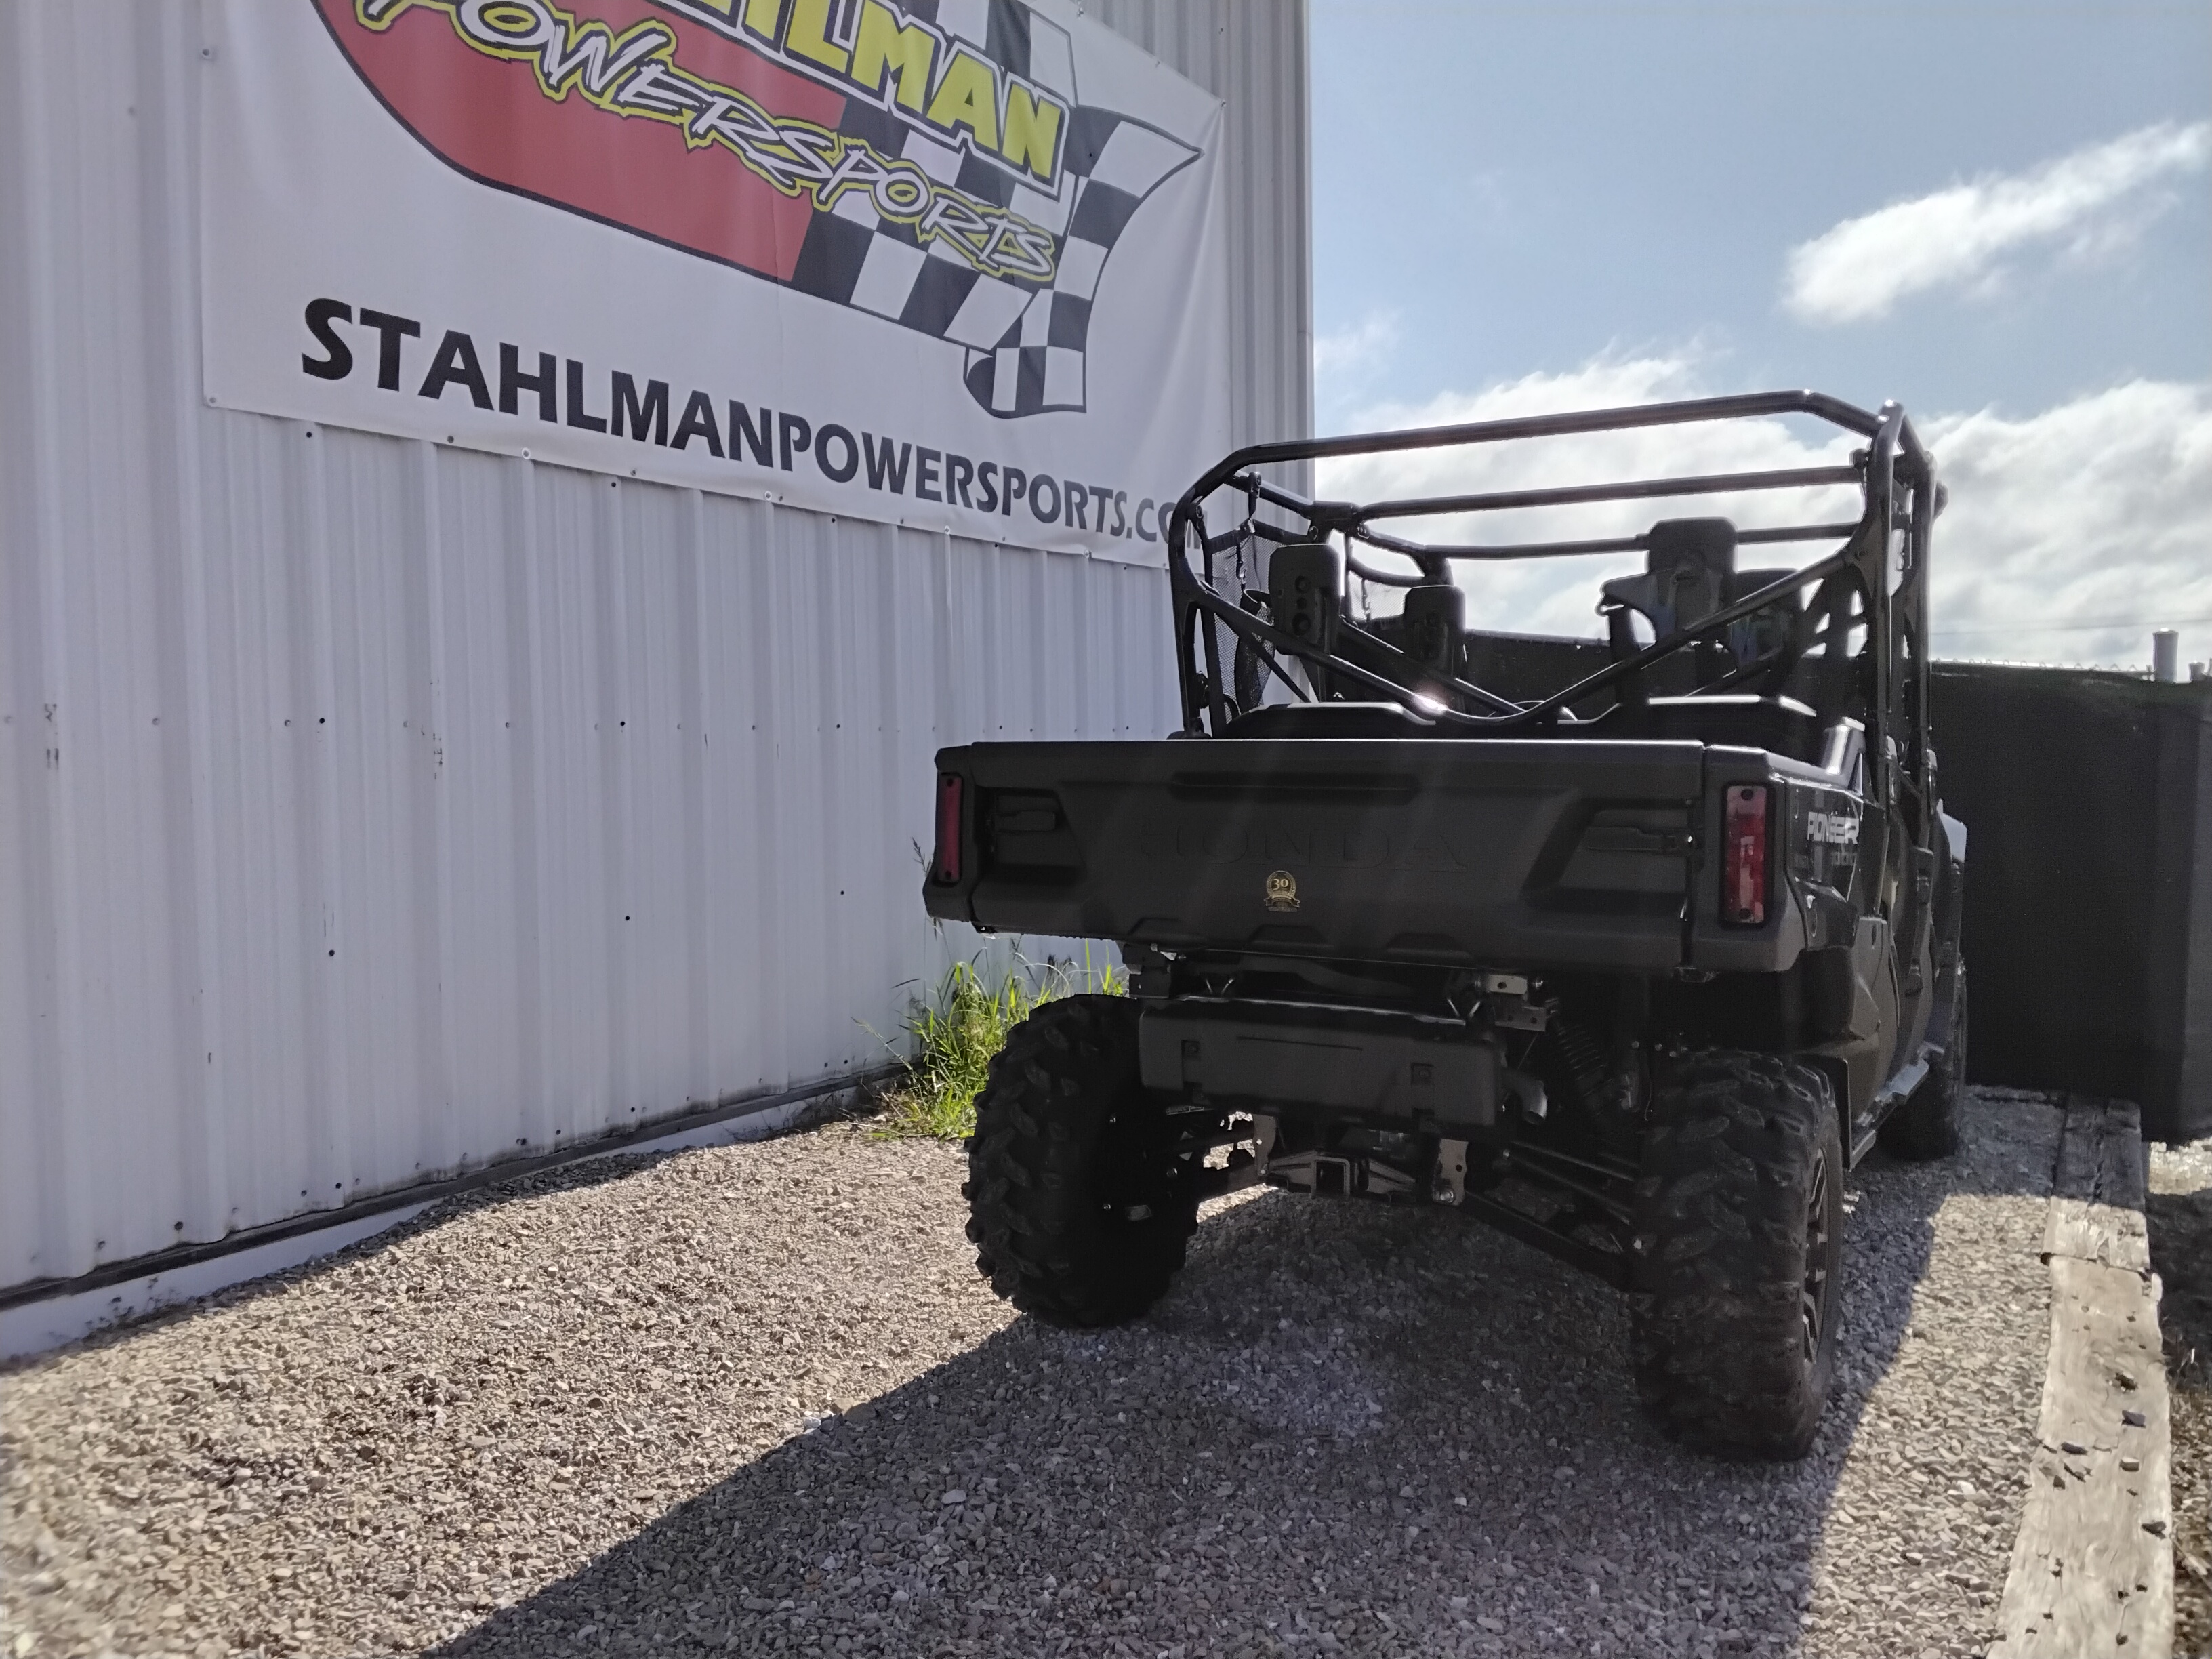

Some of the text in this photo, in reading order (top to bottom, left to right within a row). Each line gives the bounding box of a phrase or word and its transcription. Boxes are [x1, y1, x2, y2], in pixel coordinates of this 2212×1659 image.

[359, 0, 1054, 278] OWERSPORTS
[1140, 819, 1469, 872] HONDA
[1807, 811, 1859, 844] PIONEER
[1273, 878, 1289, 890] 30
